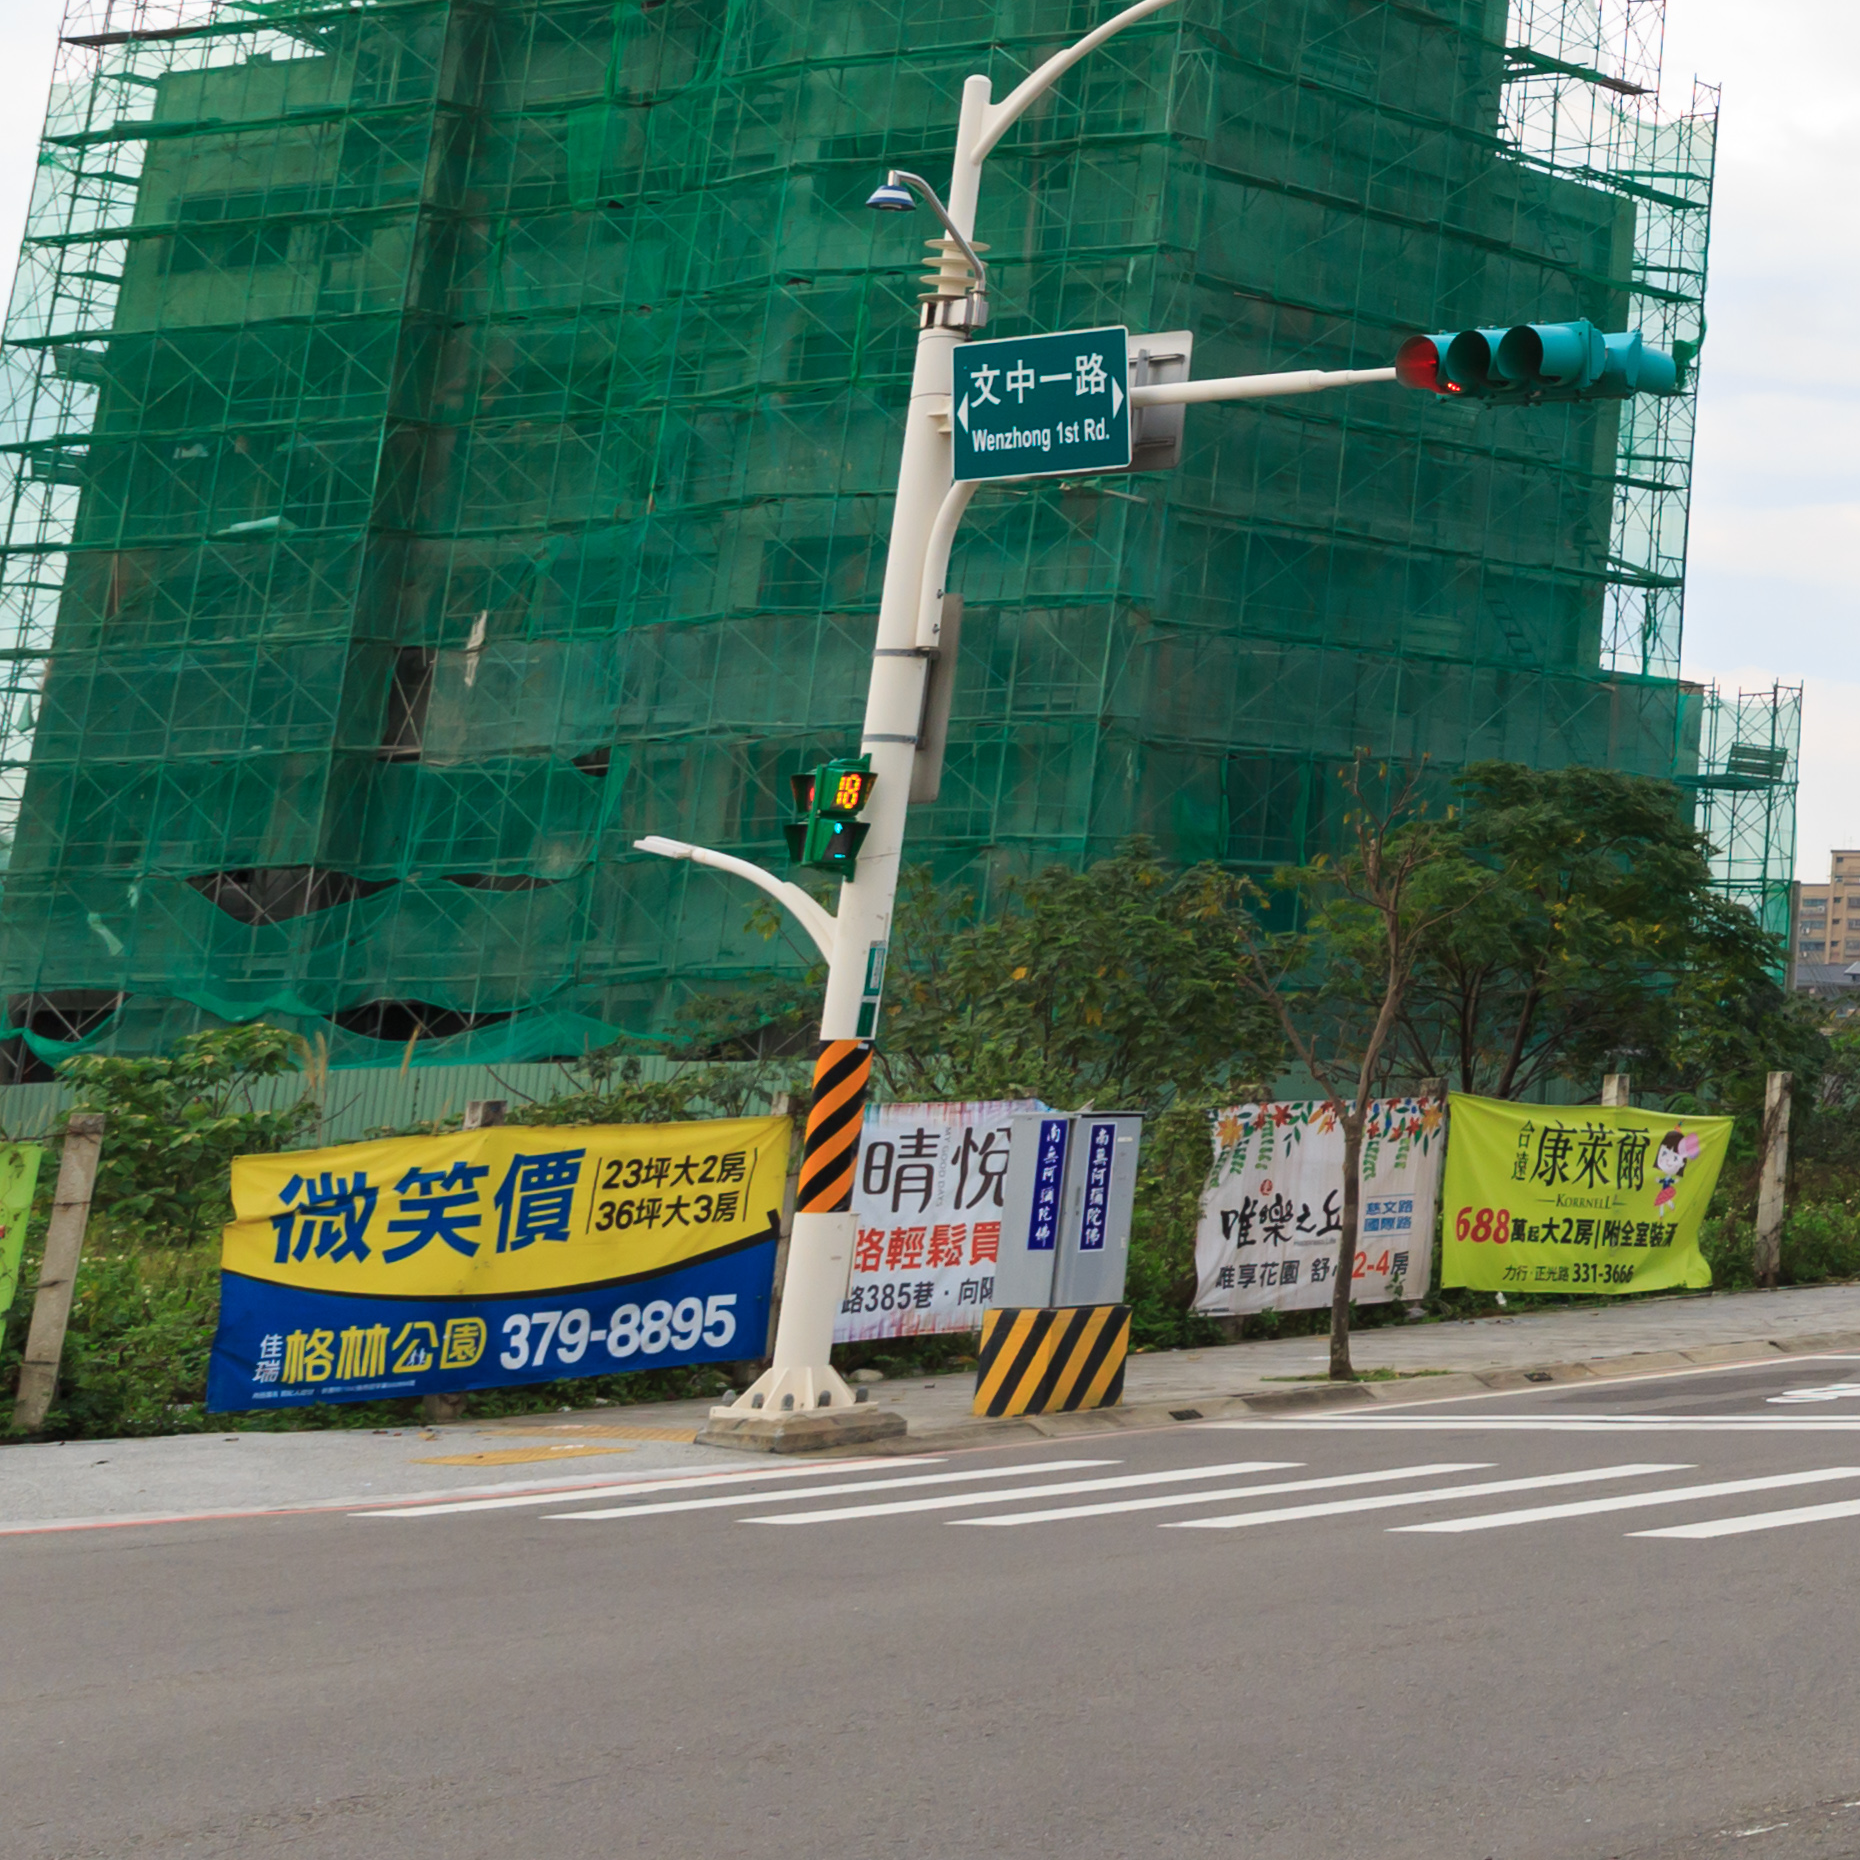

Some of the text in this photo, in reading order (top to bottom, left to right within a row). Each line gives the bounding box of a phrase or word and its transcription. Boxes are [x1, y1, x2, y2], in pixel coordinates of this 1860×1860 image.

[970, 352, 1108, 409] 文中一路
[972, 417, 1110, 453] Wenzhong 1st Rd.
[601, 1150, 746, 1190] 23坪大2房
[1528, 1119, 1651, 1191] 康萊爾
[270, 1148, 586, 1264] 微笑價
[595, 1192, 739, 1232] 36坪大3房
[1310, 1257, 1338, 1283] 舒
[1571, 1262, 1635, 1284] 331-3666
[251, 1294, 738, 1385] 佳瑞 格林公園 379-8895
